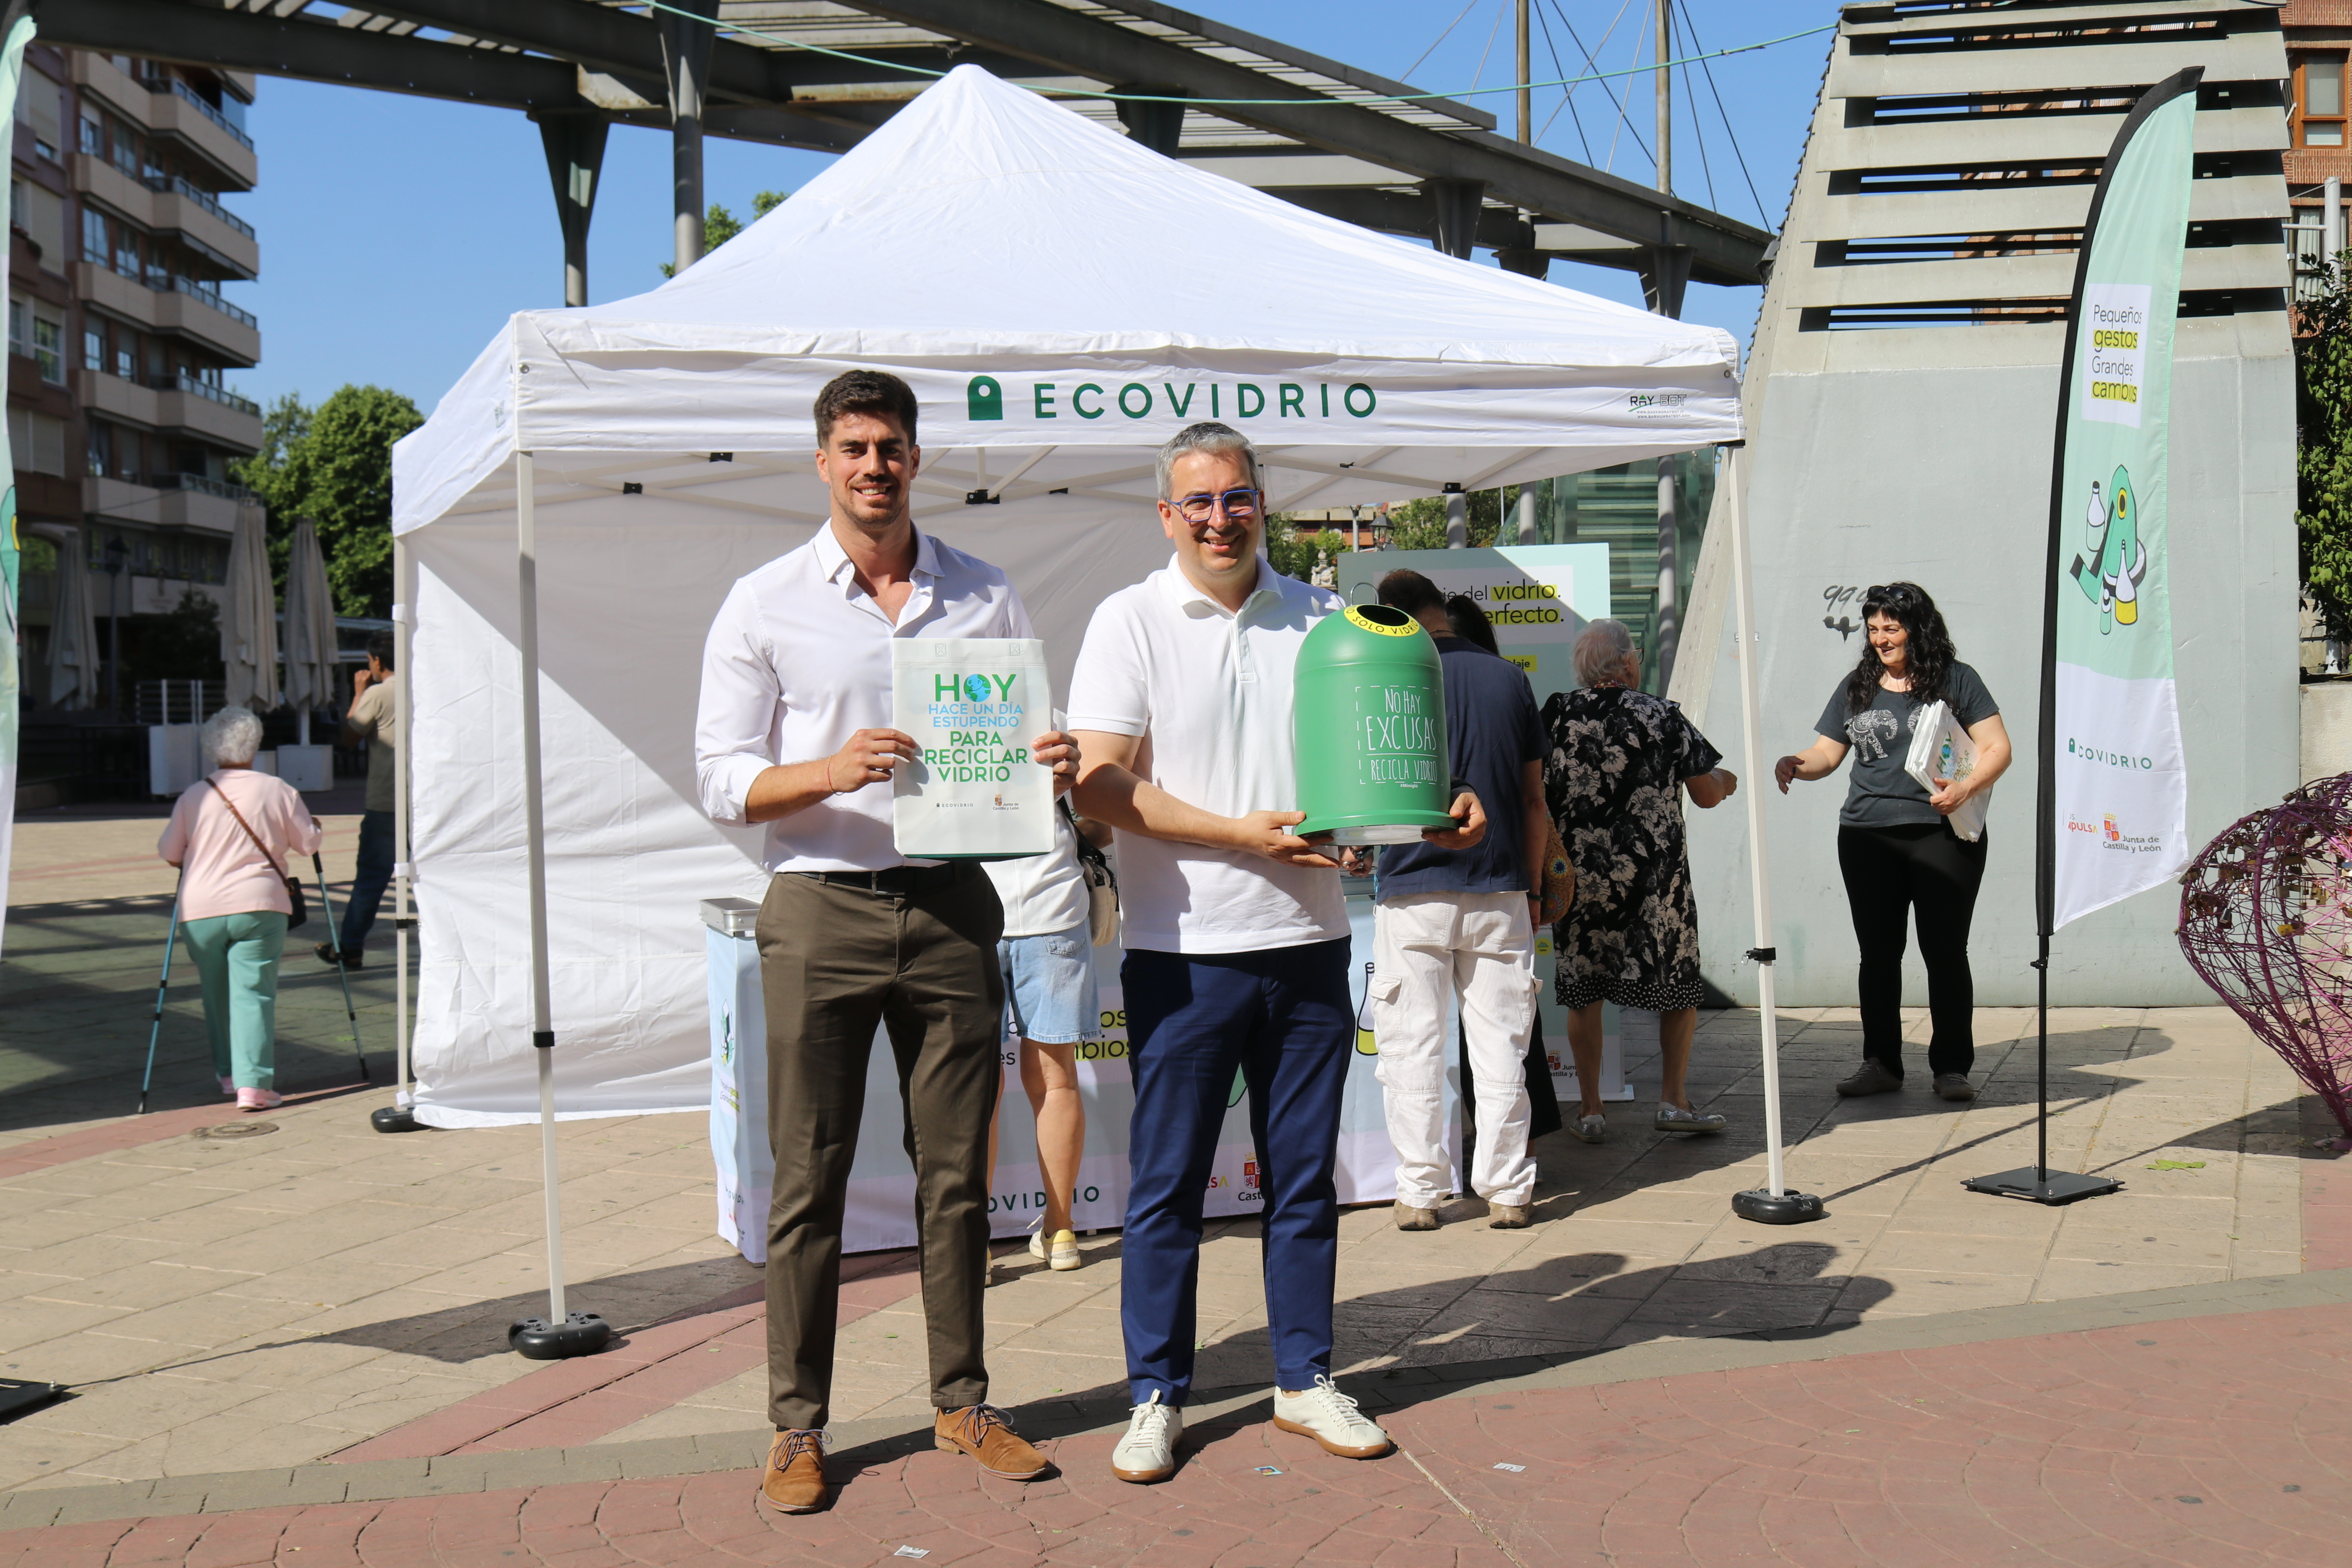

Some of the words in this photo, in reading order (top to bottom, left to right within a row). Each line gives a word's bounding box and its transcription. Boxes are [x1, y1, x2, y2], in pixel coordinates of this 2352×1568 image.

[2093, 304, 2142, 328] Pequeños
[2094, 328, 2138, 352] gestos
[2092, 356, 2133, 376] Grandes
[1034, 383, 1377, 419] ECOVIDRIO
[1660, 394, 1686, 406] BOT
[1463, 585, 1487, 601] del
[1493, 579, 1561, 600] vidrio.
[1482, 603, 1564, 624] erfecto.
[1352, 616, 1385, 632] SOLO
[1390, 620, 1418, 635] VIDRIO
[935, 673, 1016, 702] HOY
[928, 704, 968, 715] HACE
[974, 704, 994, 715] UN
[999, 702, 1023, 714] DÍA
[1385, 688, 1401, 713] NO
[1403, 690, 1421, 715] HAY
[933, 716, 1019, 728] ESTUPENDO
[950, 731, 1004, 746] PARA
[1366, 715, 1437, 751] EXCUSAS
[925, 748, 1028, 765] RECICLAR
[1958, 750, 1970, 782] CICLAR
[2078, 744, 2152, 769] COVIDRIO
[937, 766, 1010, 782] VIDRIO
[1371, 759, 1410, 780] RECICLA
[1414, 760, 1437, 782] VIDRIO
[1953, 757, 1963, 781] PARA
[2102, 841, 2129, 851] Castilla
[2122, 835, 2145, 843] Junta
[987, 1186, 1099, 1213] OVIDIO
[1238, 1191, 1264, 1201] Cast
